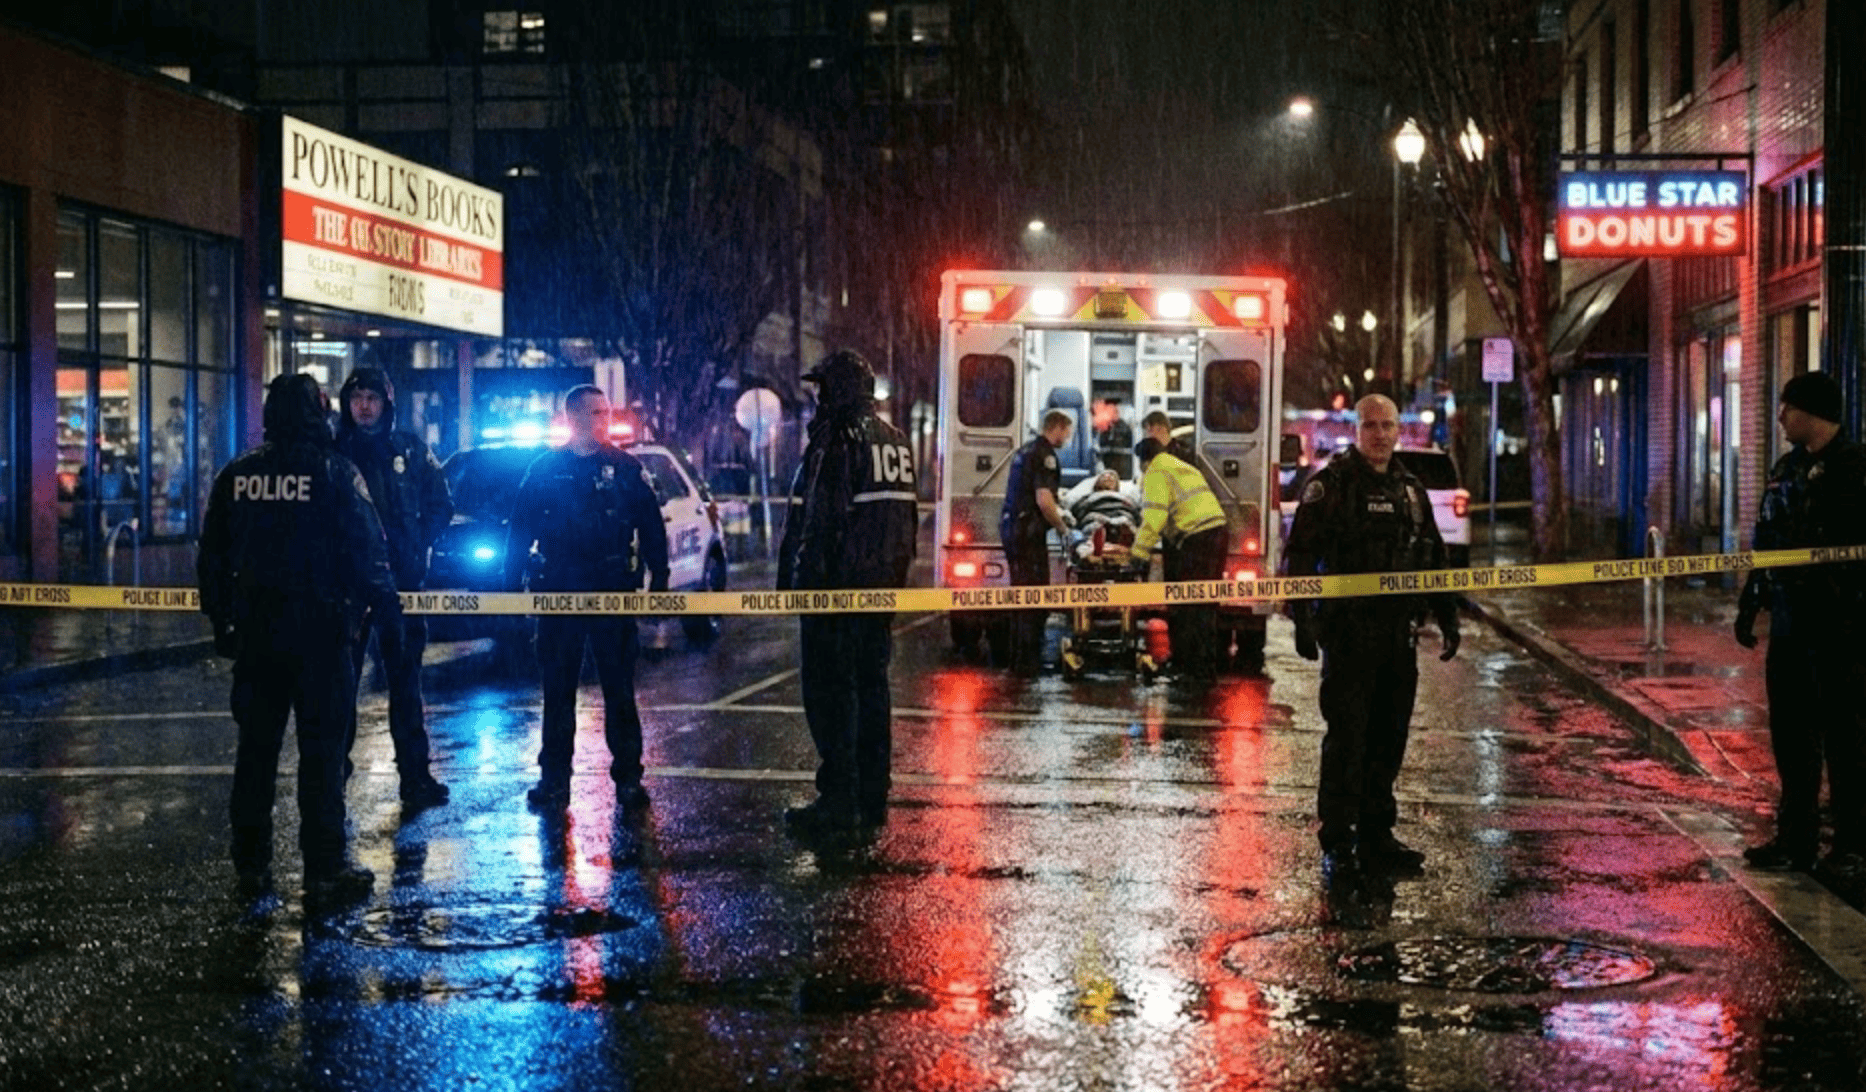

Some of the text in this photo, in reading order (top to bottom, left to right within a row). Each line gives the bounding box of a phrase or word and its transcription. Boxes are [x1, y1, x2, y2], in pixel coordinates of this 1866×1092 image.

[292, 131, 497, 241] POWELL'S BOOKS
[1567, 182, 1738, 207] BLUE STAR
[312, 205, 349, 248] THE
[1567, 215, 1738, 247] DONUTS
[871, 443, 914, 483] ICE
[233, 474, 312, 502] POLICE
[533, 595, 573, 611] POLICE
[741, 594, 781, 610] POLICE
[952, 590, 993, 607] POLICE
